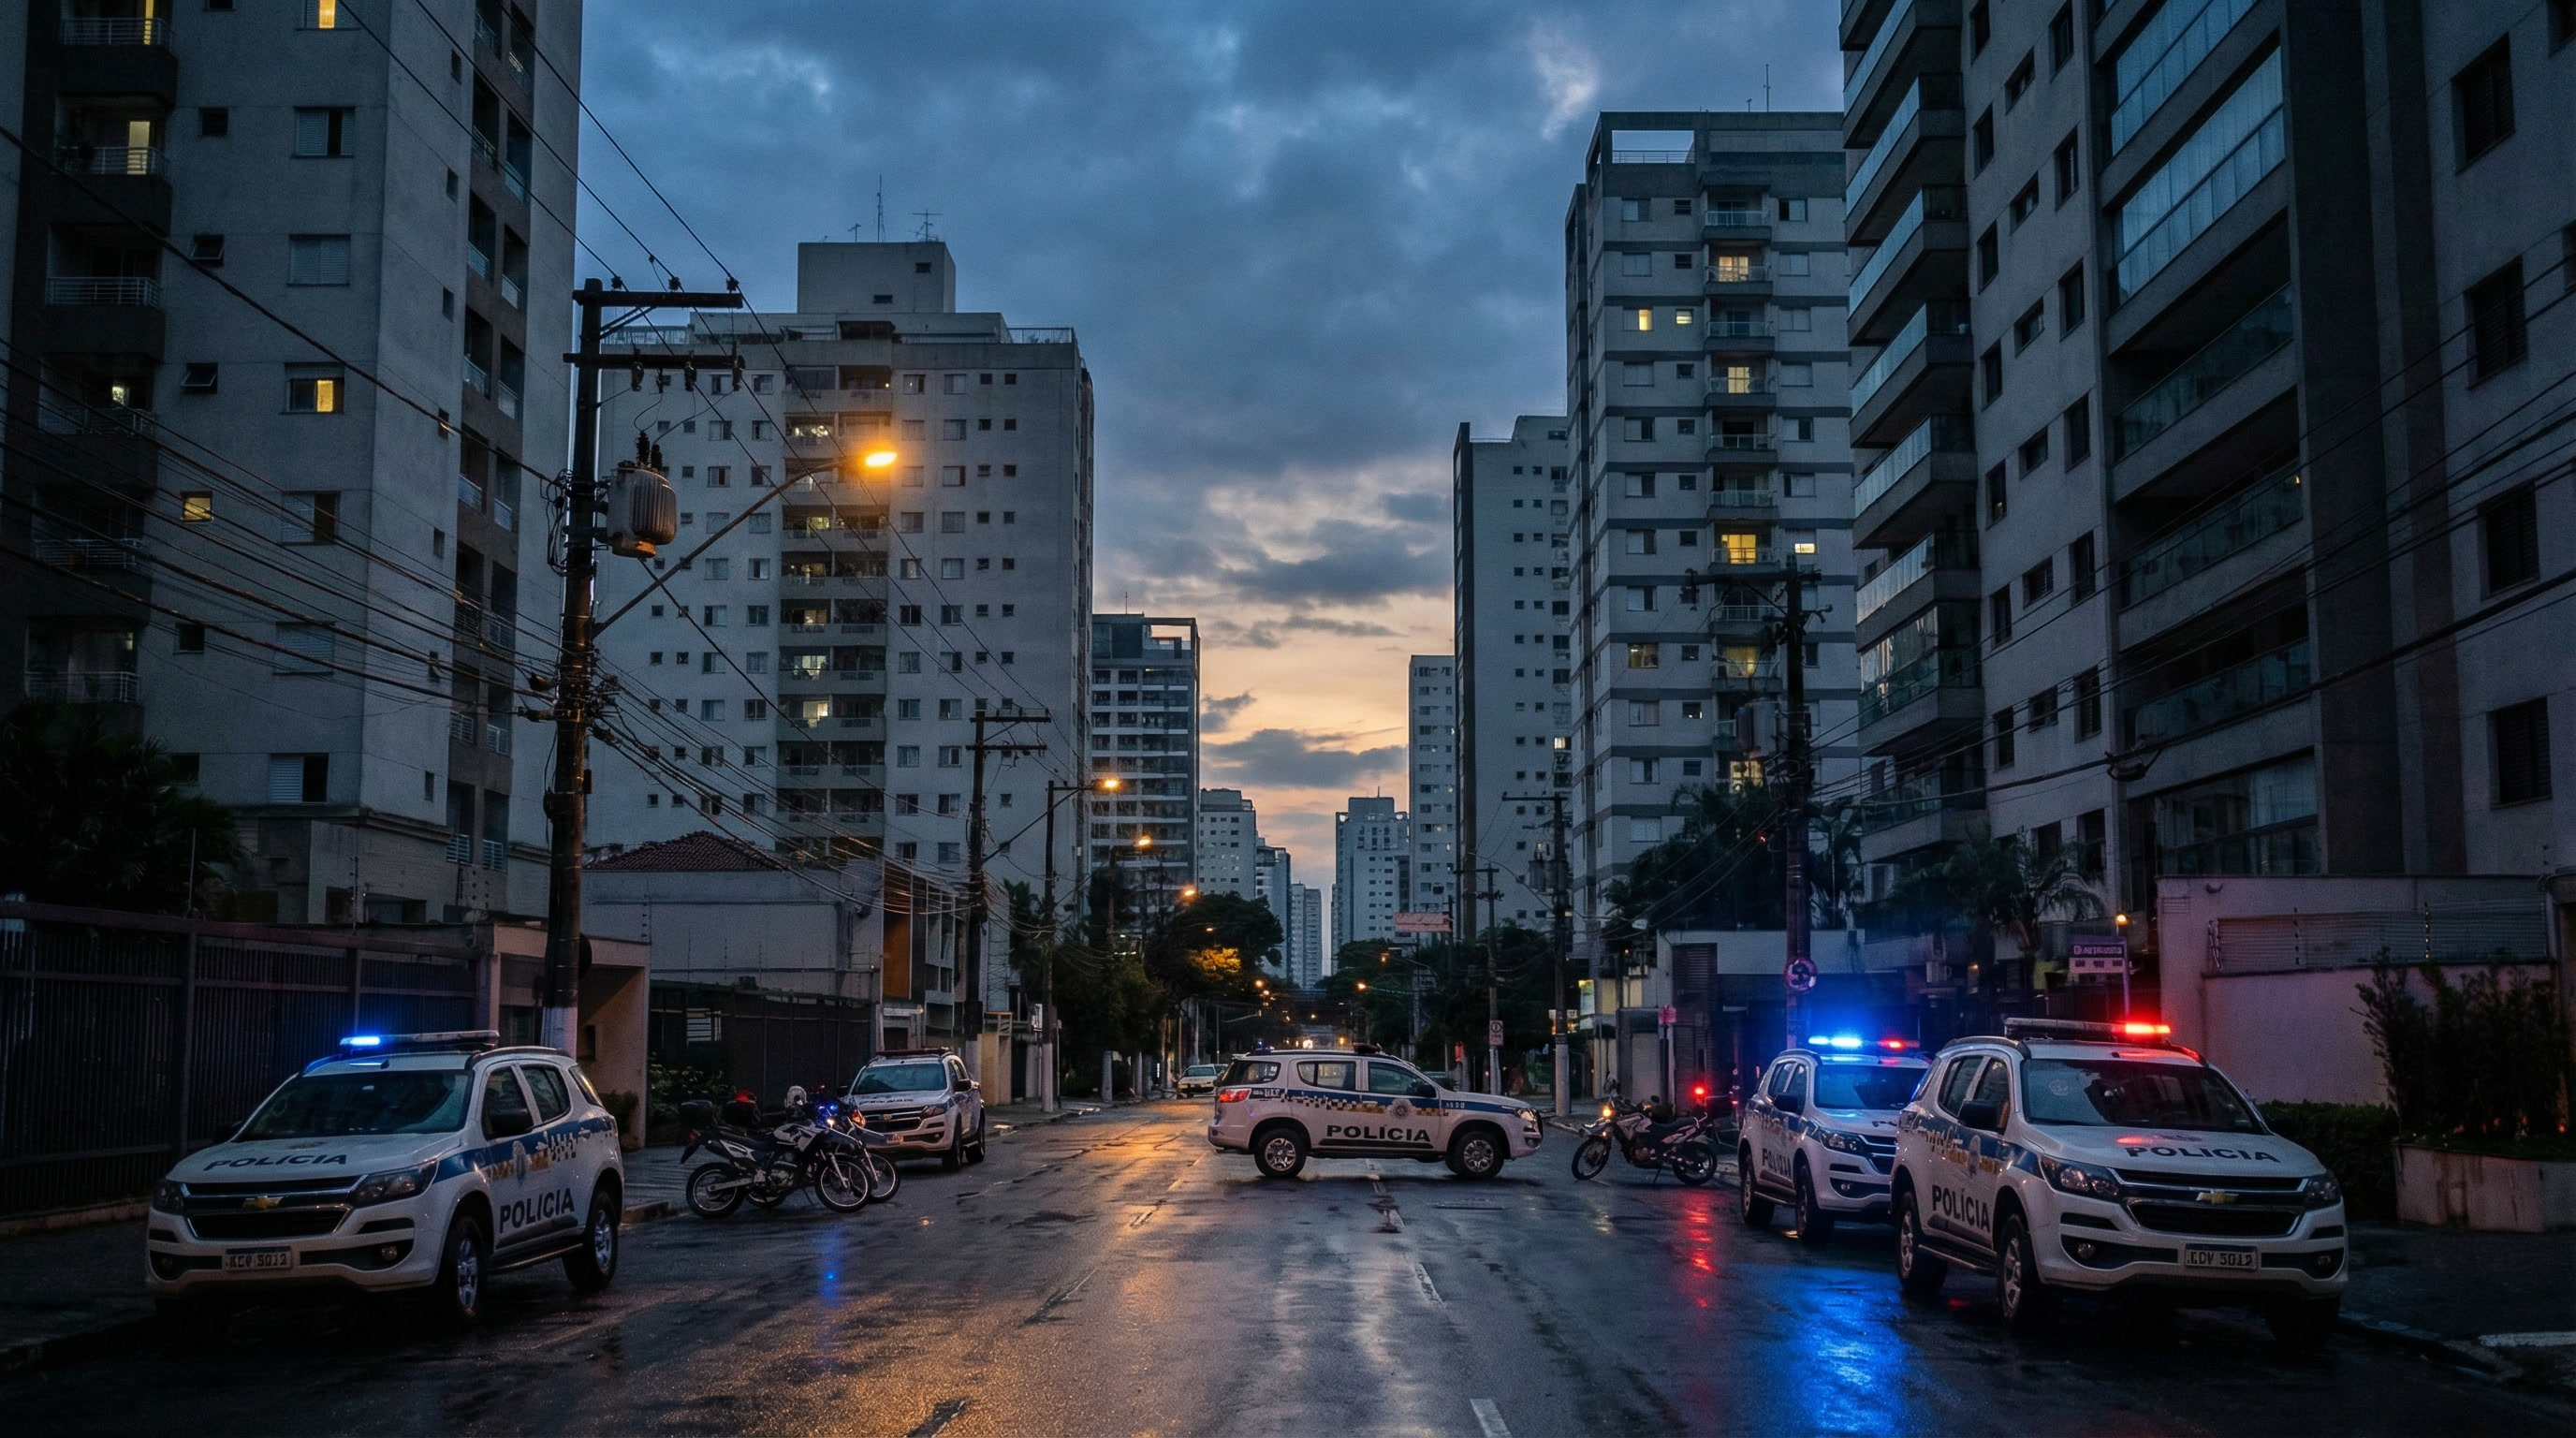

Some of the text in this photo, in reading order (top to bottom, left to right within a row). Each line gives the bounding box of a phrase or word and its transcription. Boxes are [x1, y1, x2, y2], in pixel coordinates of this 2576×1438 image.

[1326, 1123, 1431, 1143] POLÍCIA
[203, 1154, 347, 1171] POLICIA
[2125, 1147, 2281, 1164] POLICIA
[1932, 1184, 1991, 1233] POLÍCIA
